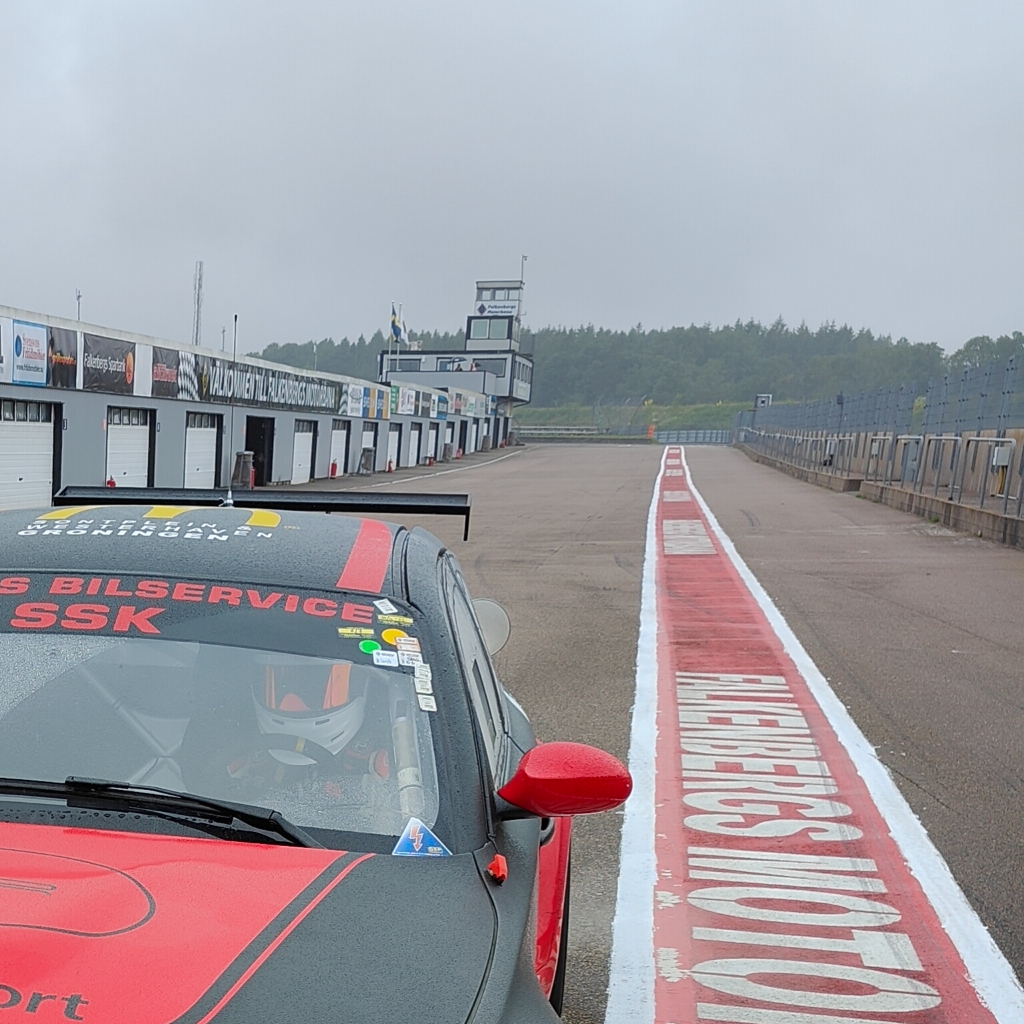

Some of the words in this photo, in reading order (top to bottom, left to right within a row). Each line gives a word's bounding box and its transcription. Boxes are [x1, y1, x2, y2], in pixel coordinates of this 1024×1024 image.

[17, 529, 230, 541] GRONINGEN
[10, 602, 166, 635] SSK
[49, 577, 374, 624] BILSERVICE
[675, 671, 864, 841] FALKENBERGS
